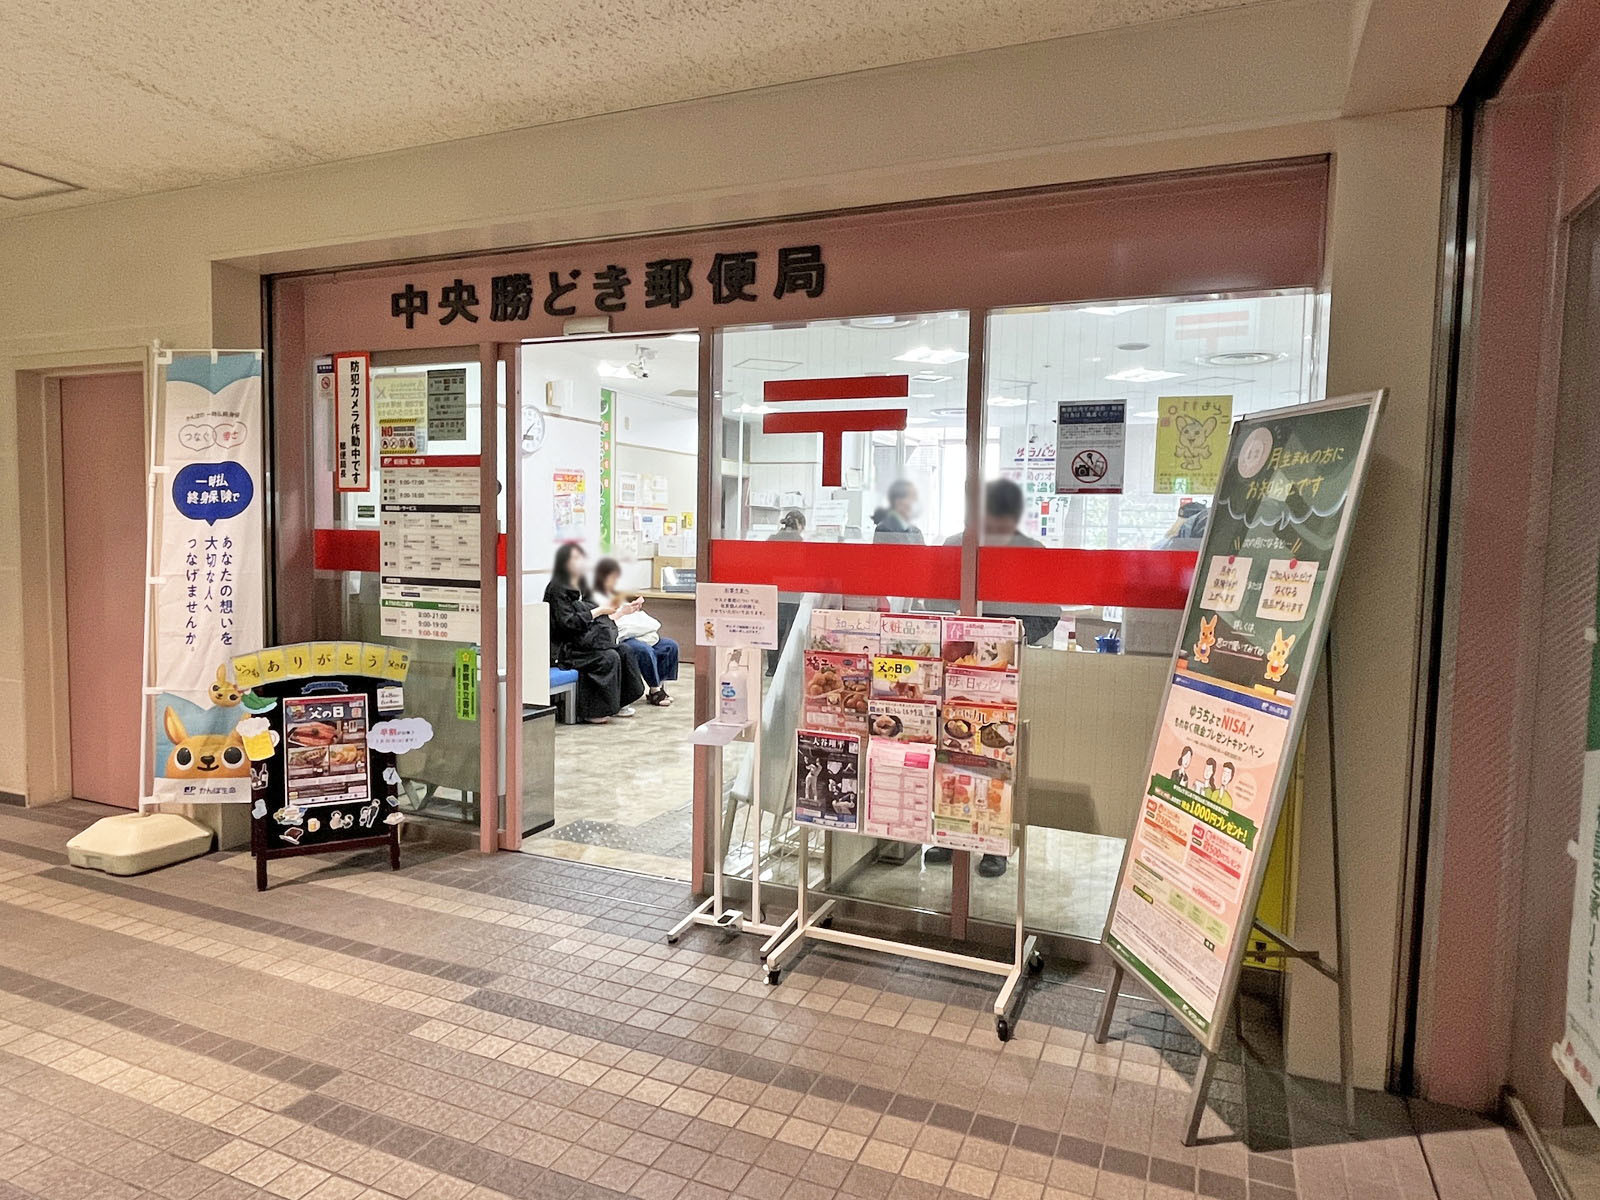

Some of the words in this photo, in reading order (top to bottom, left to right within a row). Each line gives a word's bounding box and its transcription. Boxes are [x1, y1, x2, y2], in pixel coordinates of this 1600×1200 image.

[391, 245, 826, 329] 中央勝どき郵便局
[350, 360, 361, 485] 防犯カメラ作動中です
[381, 426, 393, 437] NO
[184, 432, 209, 442] つなぐ
[1267, 448, 1345, 470] 月生まれの方に
[187, 490, 240, 504] 終身保険で
[1246, 476, 1324, 500] お知らせです
[203, 536, 218, 613] 大切な人へ
[185, 538, 198, 645] つなげませんか
[219, 536, 233, 645] あなたの想いを
[418, 620, 448, 629] 9:00-19:00
[235, 664, 260, 678] いつも
[267, 653, 378, 673] ありがとう
[388, 659, 407, 670] 父の日
[878, 662, 903, 674] 父の日
[309, 706, 344, 719] 父の日
[1175, 717, 1265, 758] もれなく現金プレゼントキャンペーン
